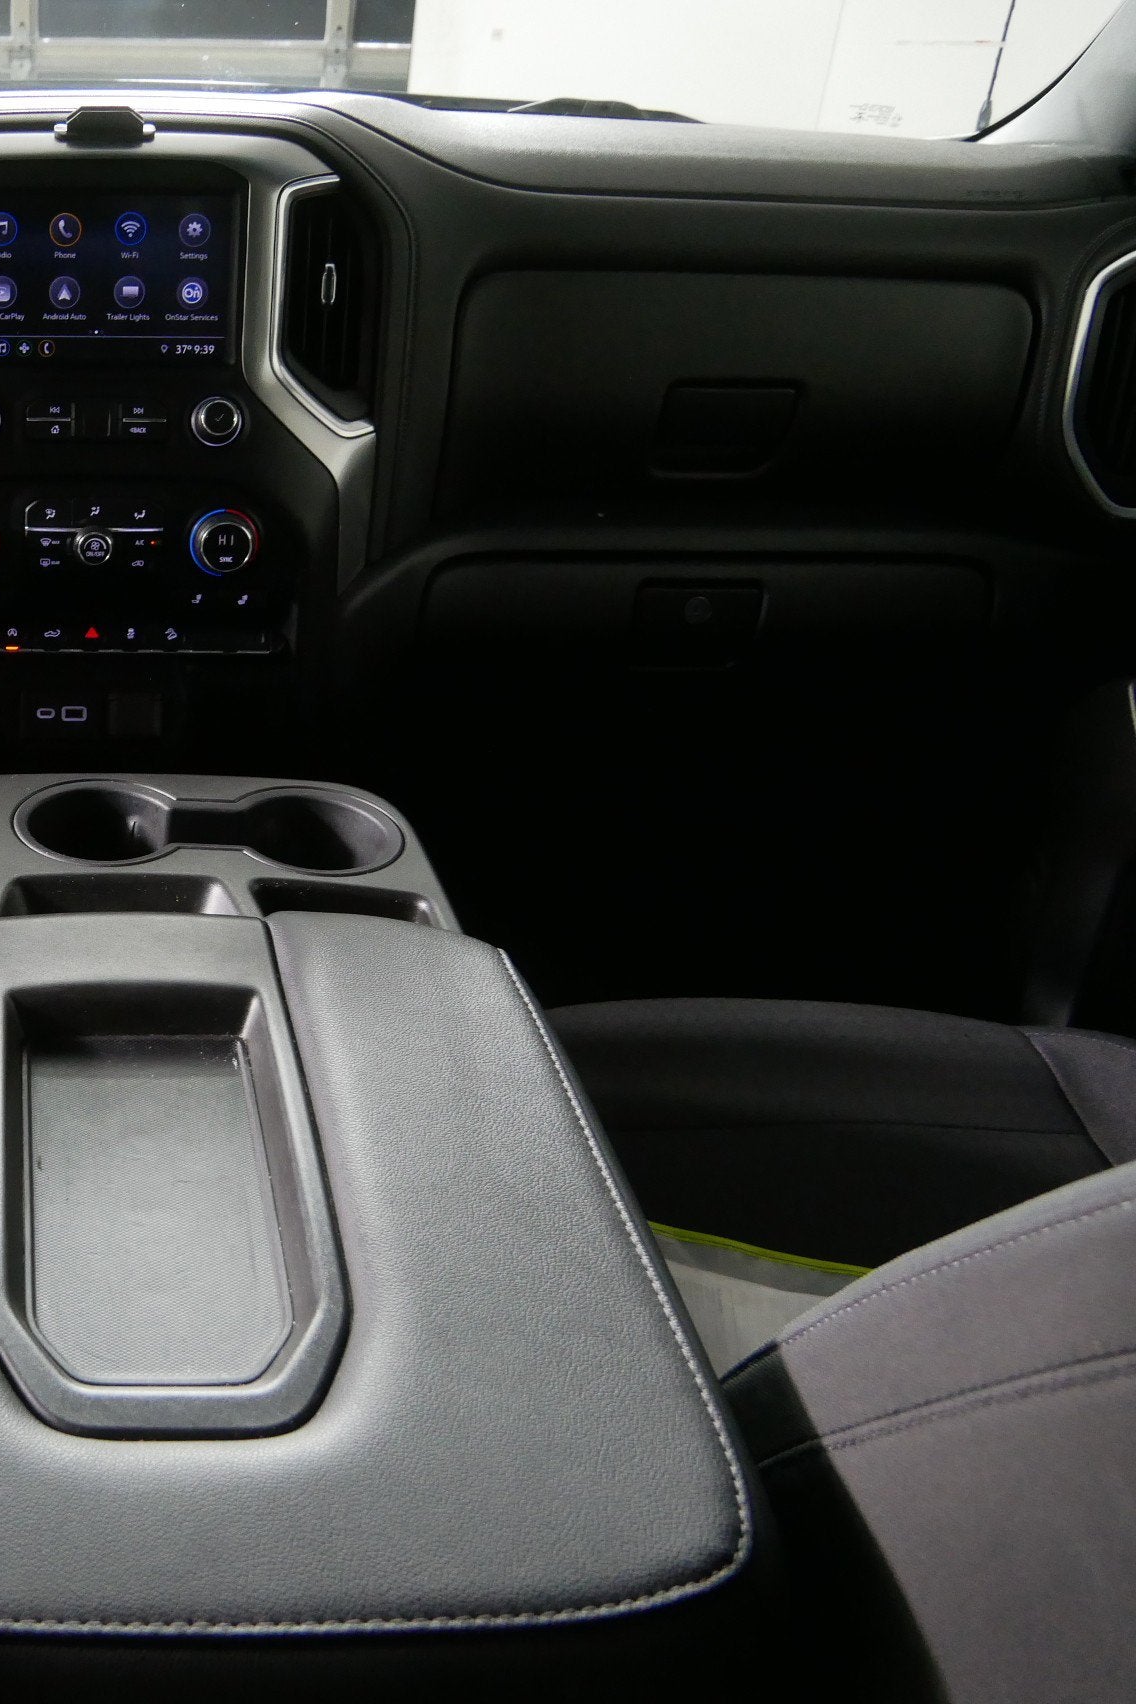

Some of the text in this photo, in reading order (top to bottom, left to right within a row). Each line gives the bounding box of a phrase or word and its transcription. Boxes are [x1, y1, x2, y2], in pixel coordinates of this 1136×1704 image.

[54, 251, 76, 259] Phone
[120, 251, 139, 259] Wi-Fi
[179, 252, 208, 260] Settings
[0, 312, 25, 321] CarPlay
[42, 312, 87, 320] Android Auto
[106, 312, 150, 321] Trailer Lights
[165, 313, 218, 321] OnStar Services
[194, 344, 215, 354] 9:39
